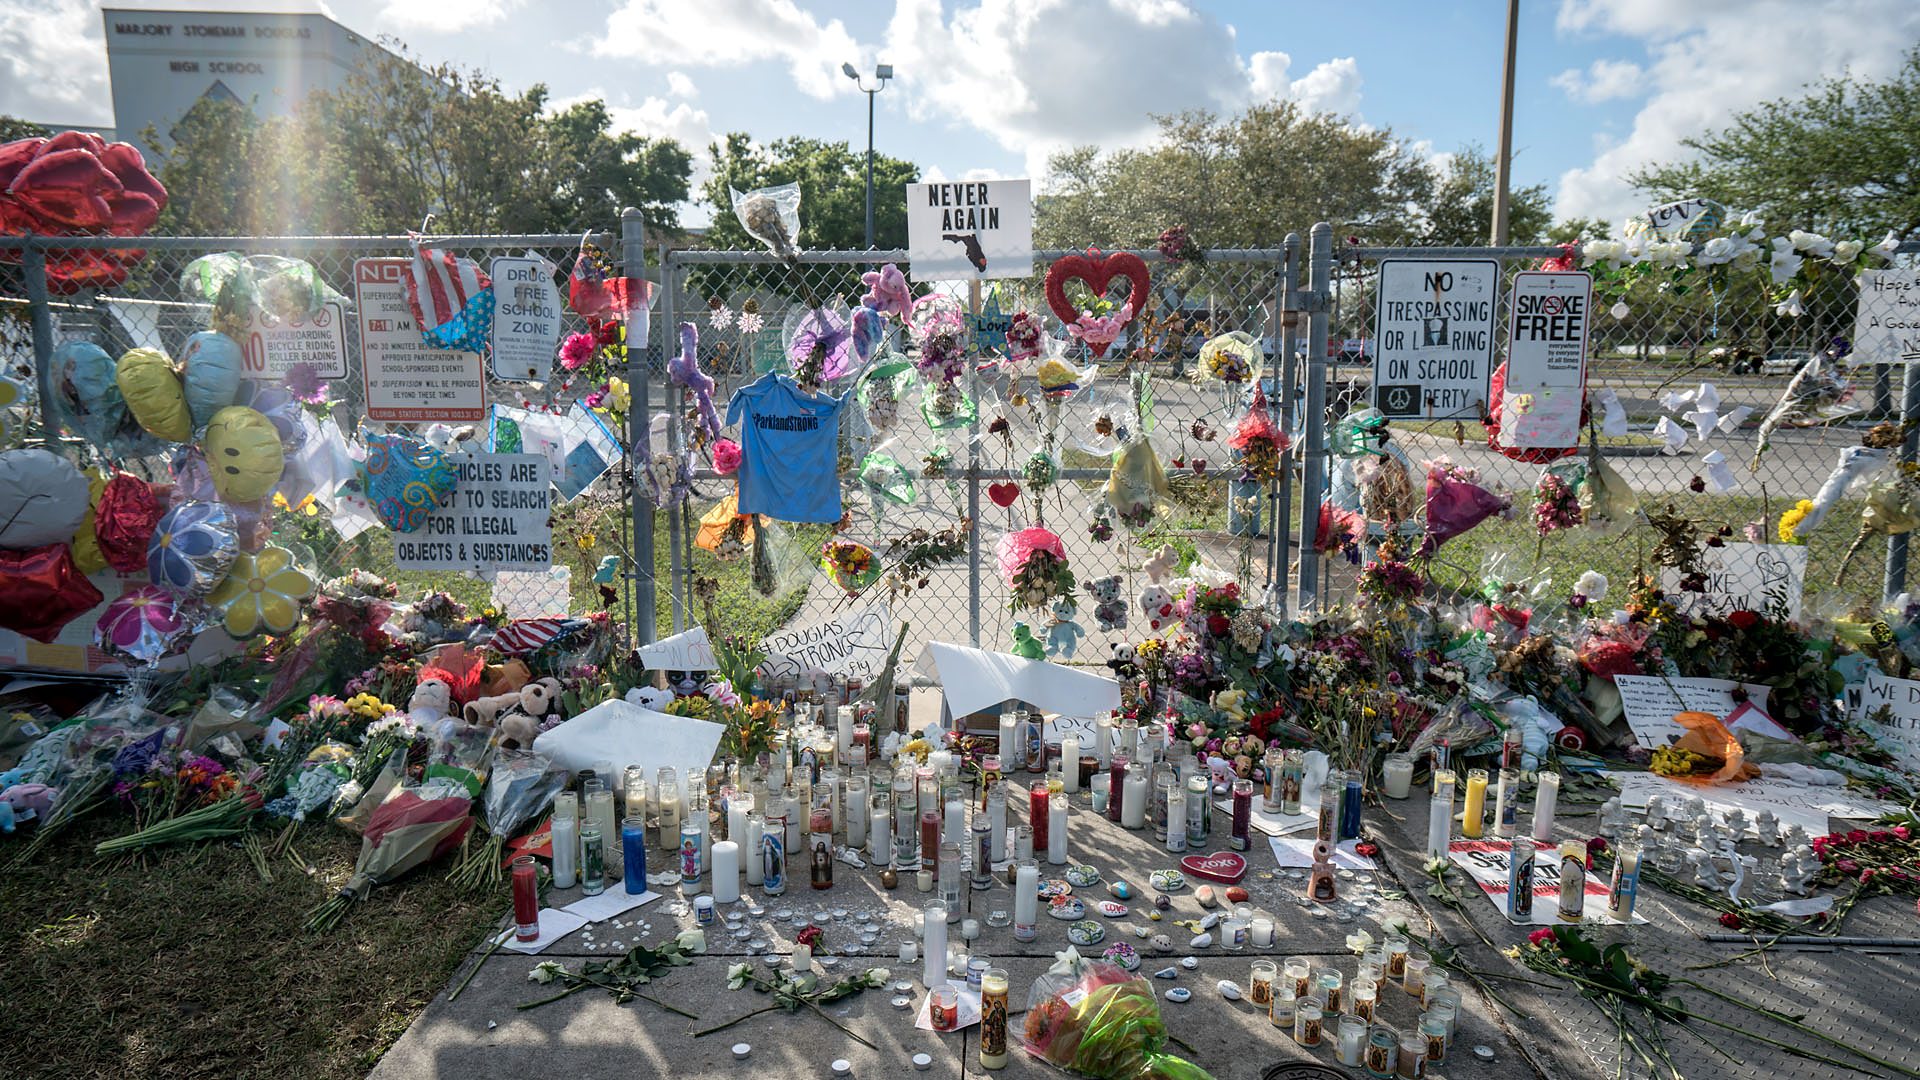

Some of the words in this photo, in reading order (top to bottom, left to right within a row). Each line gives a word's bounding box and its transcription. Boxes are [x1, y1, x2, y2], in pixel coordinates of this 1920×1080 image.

[115, 23, 172, 36] MARJORY
[183, 24, 245, 38] STONEMAN
[255, 26, 311, 39] DOUGLAS
[169, 61, 199, 73] HIGH
[208, 61, 264, 74] SCHOOL
[928, 183, 988, 206] NEVER
[942, 207, 999, 231] AGAIN
[507, 269, 550, 283] DRUG-
[1424, 271, 1454, 292] NO
[1874, 275, 1911, 296] Hope
[514, 287, 548, 301] FREE
[502, 303, 555, 319] SCHOOL
[1387, 301, 1488, 321] TRESPASSING
[396, 322, 410, 332] AM
[512, 321, 549, 336] ZONE
[1515, 316, 1581, 341] FREE
[1871, 316, 1879, 328] A
[266, 330, 332, 340] SKATEBOARDING
[1385, 330, 1405, 351] OR
[1413, 331, 1487, 351] LRING
[267, 340, 304, 351] BICYCLE
[305, 340, 336, 351] RIDING
[268, 351, 301, 361] ROLLER
[302, 351, 337, 361] BLADING
[382, 365, 440, 373] SCHOOL-SPONSORED
[442, 365, 464, 373] EVENTS
[1388, 359, 1409, 379] ON
[1417, 359, 1478, 380] SCHOOL
[393, 391, 416, 399] BEYOND
[418, 391, 436, 399] THESE
[439, 391, 456, 399] TIMES
[1423, 389, 1471, 409] PERTY
[456, 463, 501, 482] HICLES
[509, 463, 538, 482] ARE
[465, 490, 485, 509] TO
[491, 490, 547, 509] SEARCH
[427, 516, 455, 536] FOR
[462, 516, 518, 536] ILLEGAL
[398, 543, 453, 561] OBJECTS
[459, 544, 467, 561] &
[473, 543, 548, 562] SUBSTANCES
[786, 634, 853, 677] STRONG
[1868, 677, 1896, 700] WE
[1196, 859, 1238, 869] XOXO
